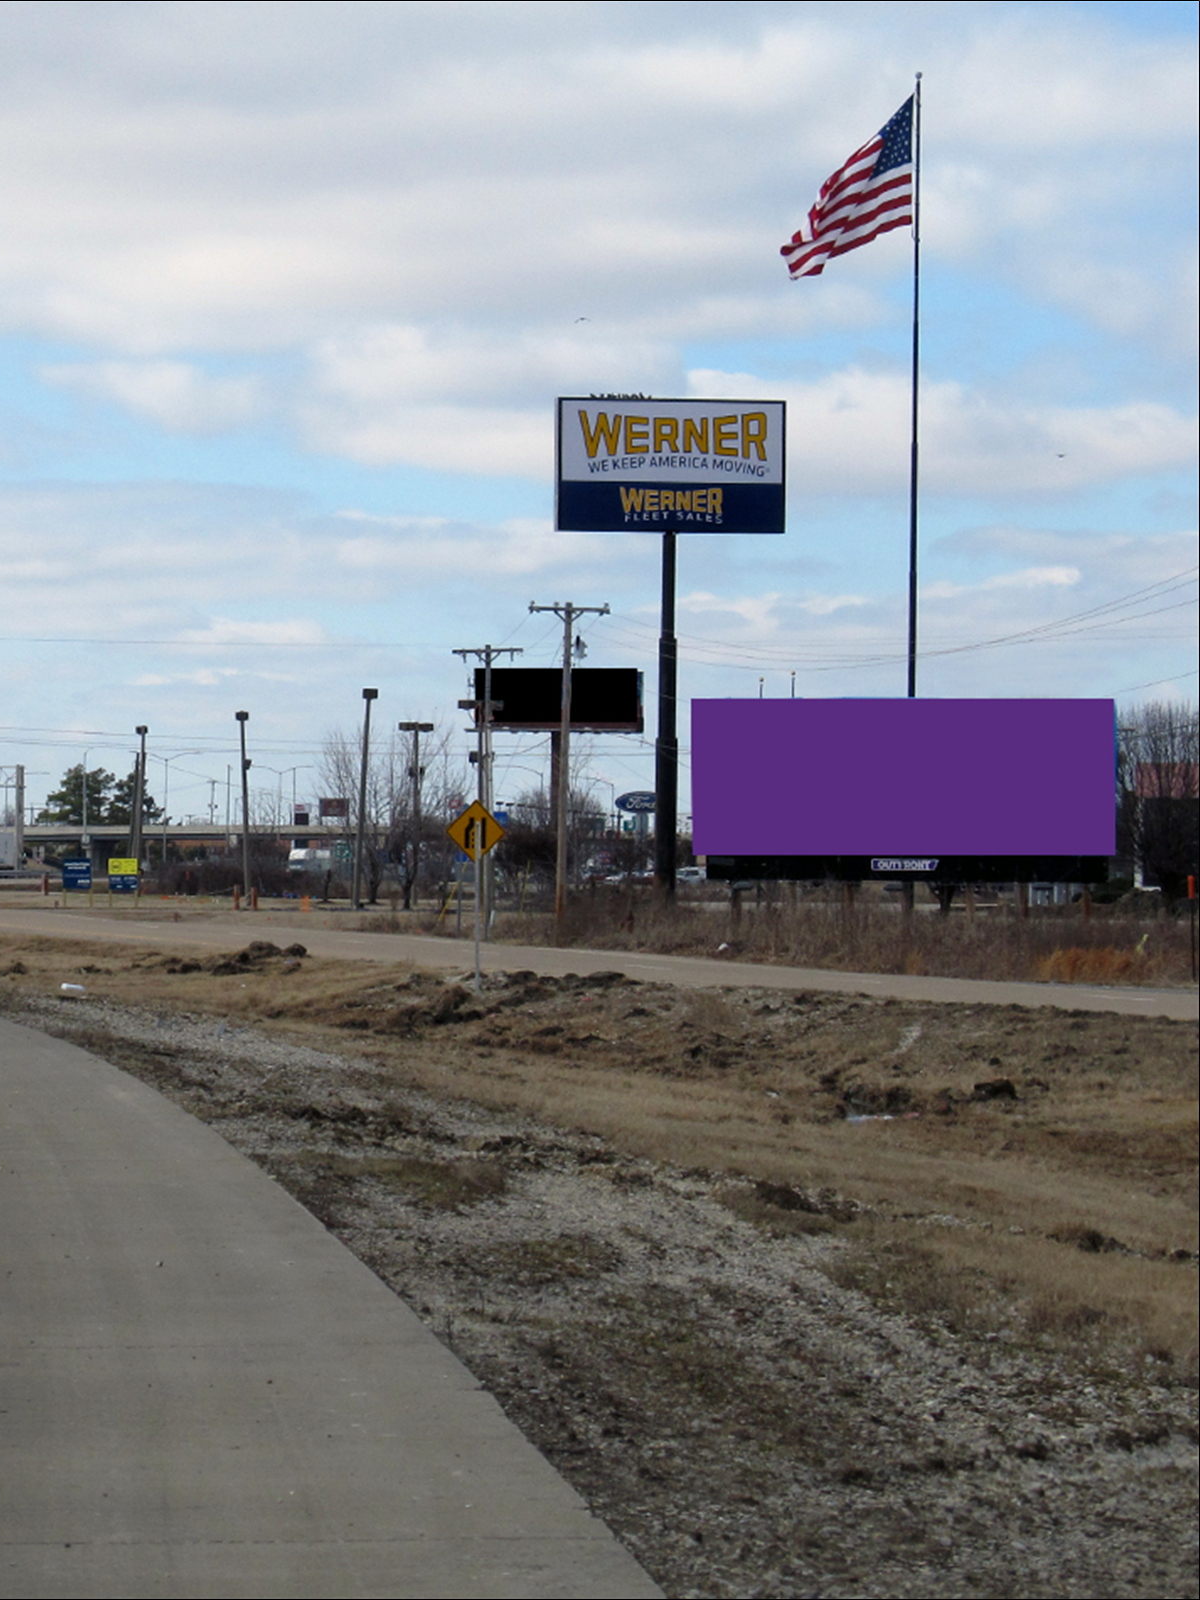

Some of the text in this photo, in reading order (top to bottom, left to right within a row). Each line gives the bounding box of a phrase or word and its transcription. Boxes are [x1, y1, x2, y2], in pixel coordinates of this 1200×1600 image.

[578, 409, 768, 462] WERNER
[588, 460, 609, 474] WE
[612, 456, 646, 471] KEEP
[650, 455, 709, 470] AMERICA
[619, 486, 723, 515] WERNER
[624, 511, 724, 525] FLEET SALES
